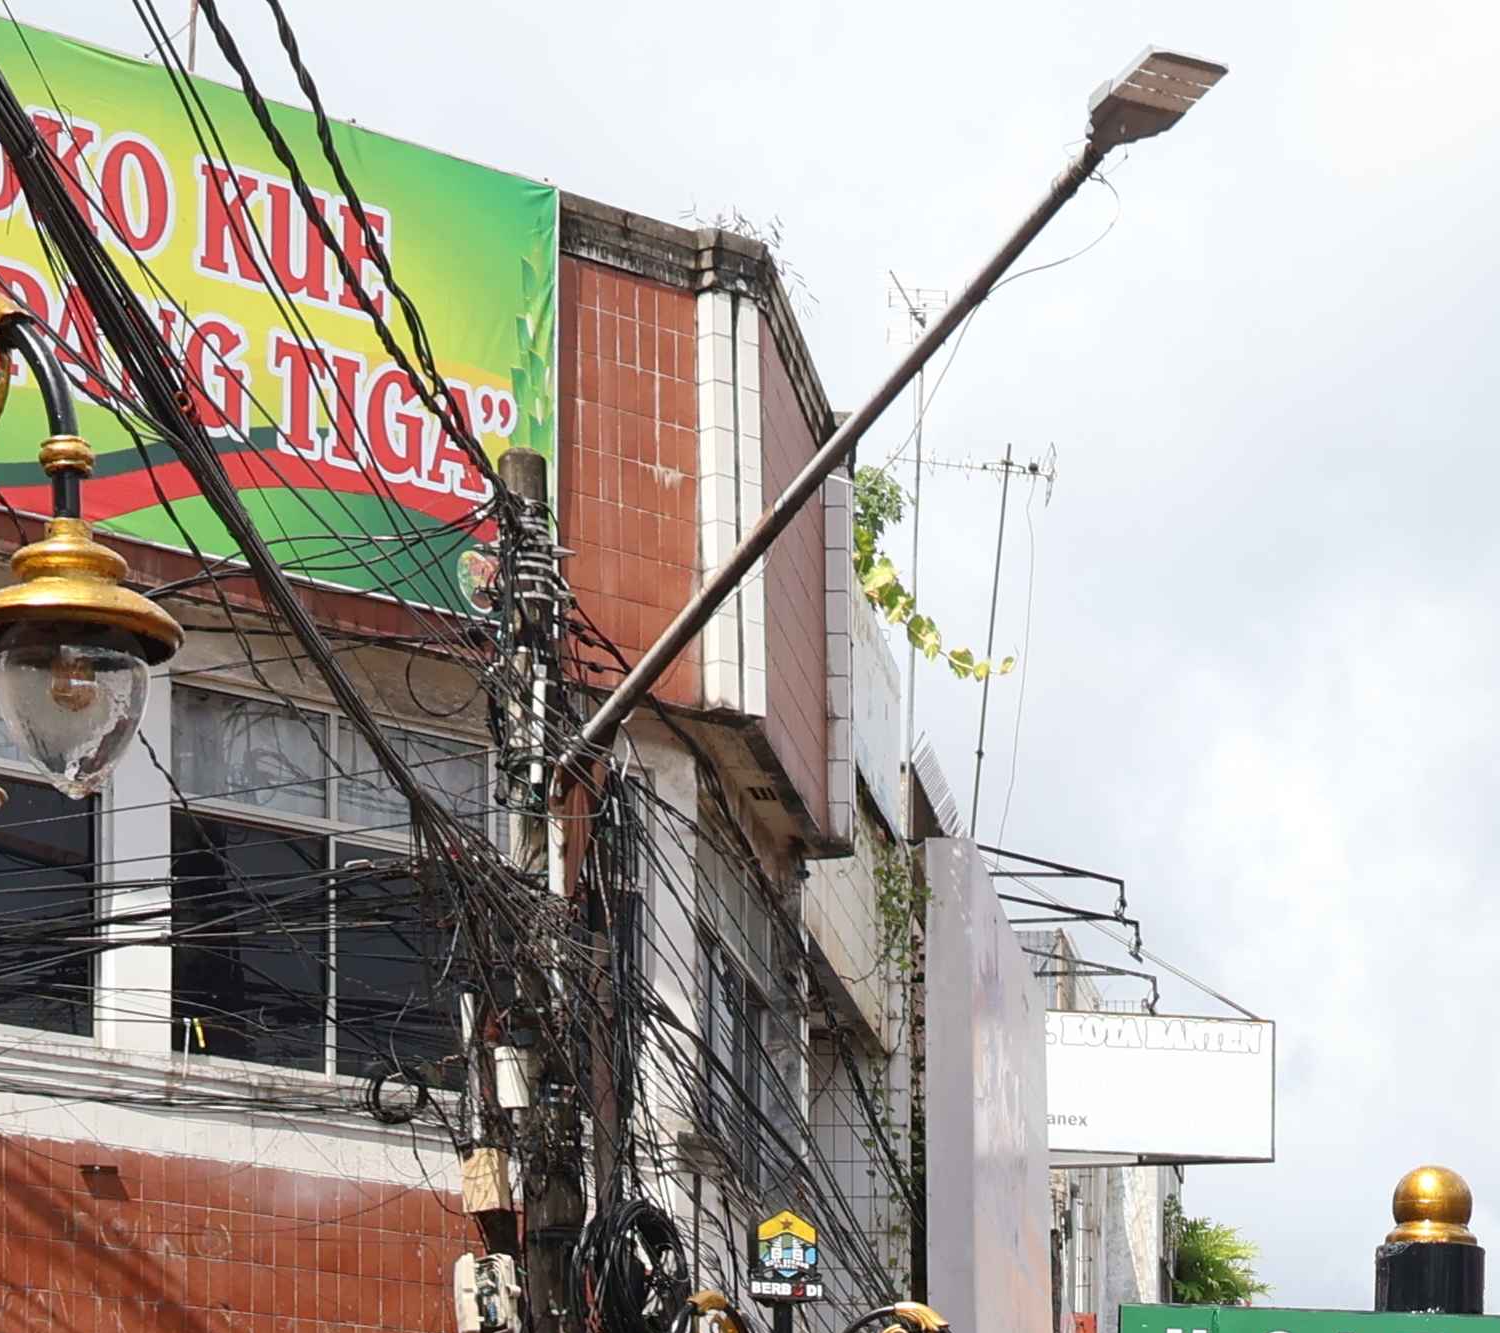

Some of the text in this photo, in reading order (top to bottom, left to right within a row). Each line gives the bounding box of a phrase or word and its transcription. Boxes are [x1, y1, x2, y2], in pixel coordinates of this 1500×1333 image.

[200, 164, 390, 311] KUE
[1061, 1014, 1142, 1048] KOTA
[1145, 1018, 1263, 1054] BANTEN
